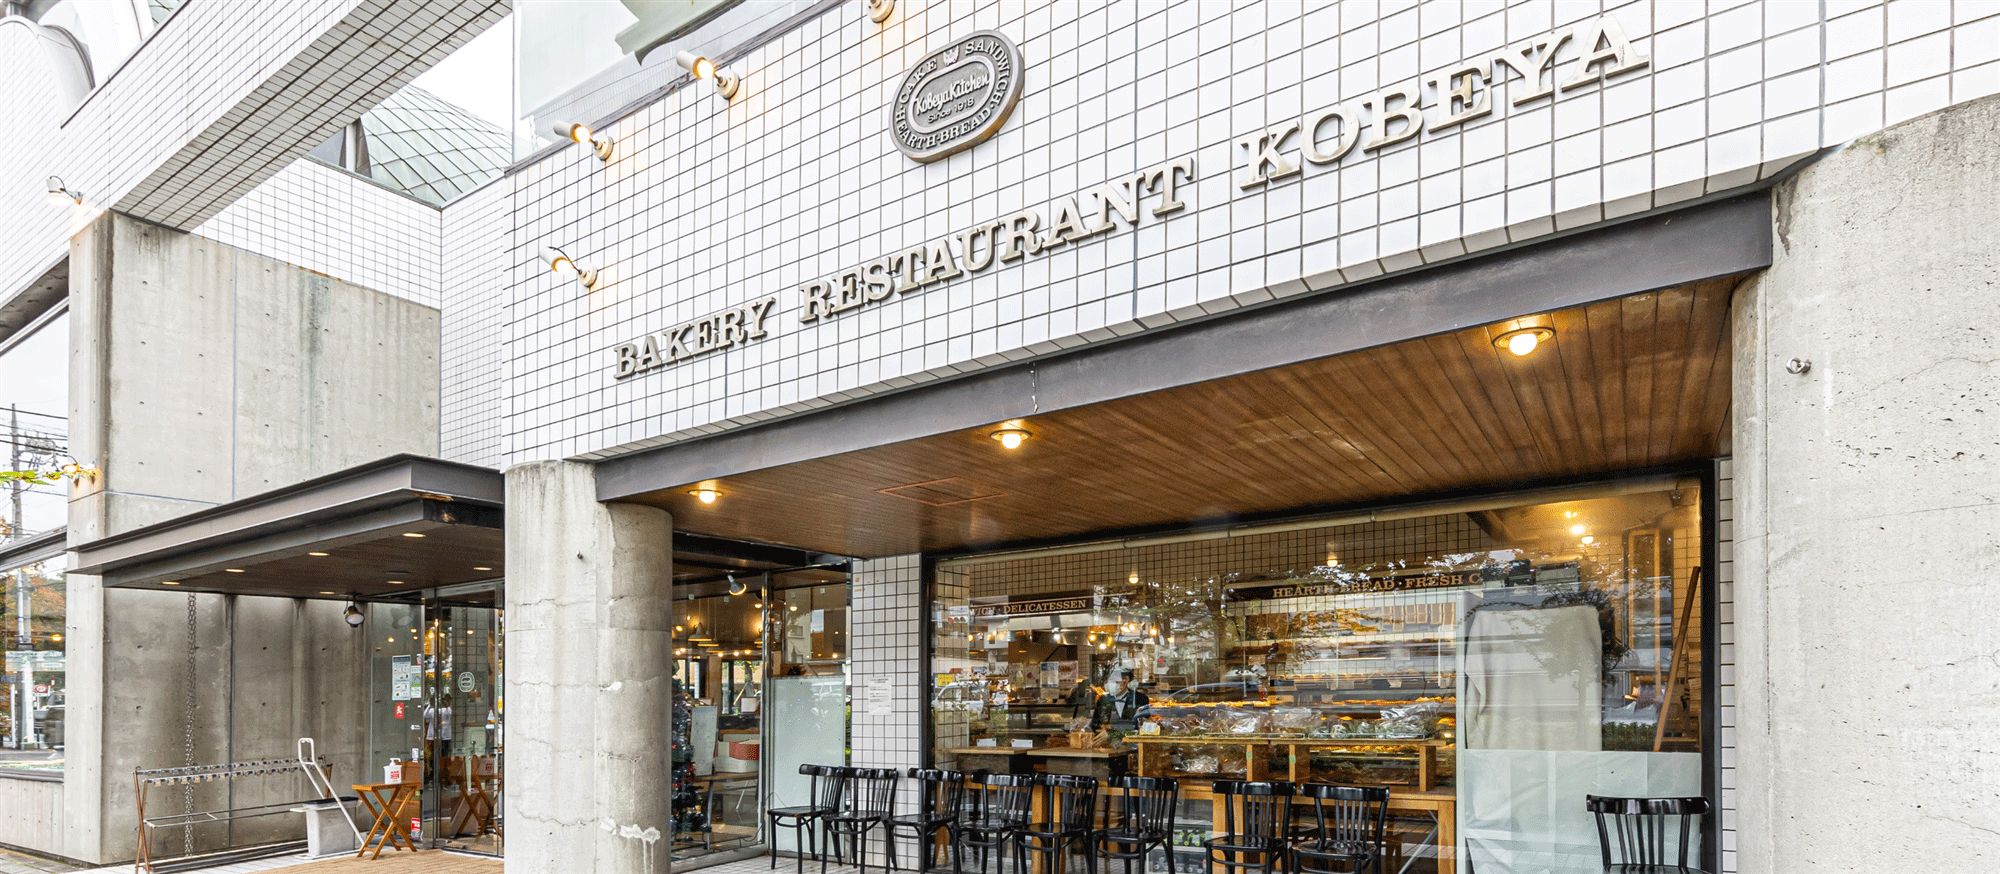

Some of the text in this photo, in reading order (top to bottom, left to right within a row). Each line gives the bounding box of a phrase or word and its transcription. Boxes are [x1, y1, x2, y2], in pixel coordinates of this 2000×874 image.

[900, 39, 1010, 107] CAKE SANDWICH
[954, 97, 974, 111] 1918
[896, 107, 992, 150] HEARTH BREAD
[613, 13, 1650, 380] BAKERY RESTAURANT KOBEYA
[1272, 583, 1336, 598] HEARTH
[1405, 574, 1463, 588] FRESH
[1003, 599, 1087, 615] DELICATESSEN
